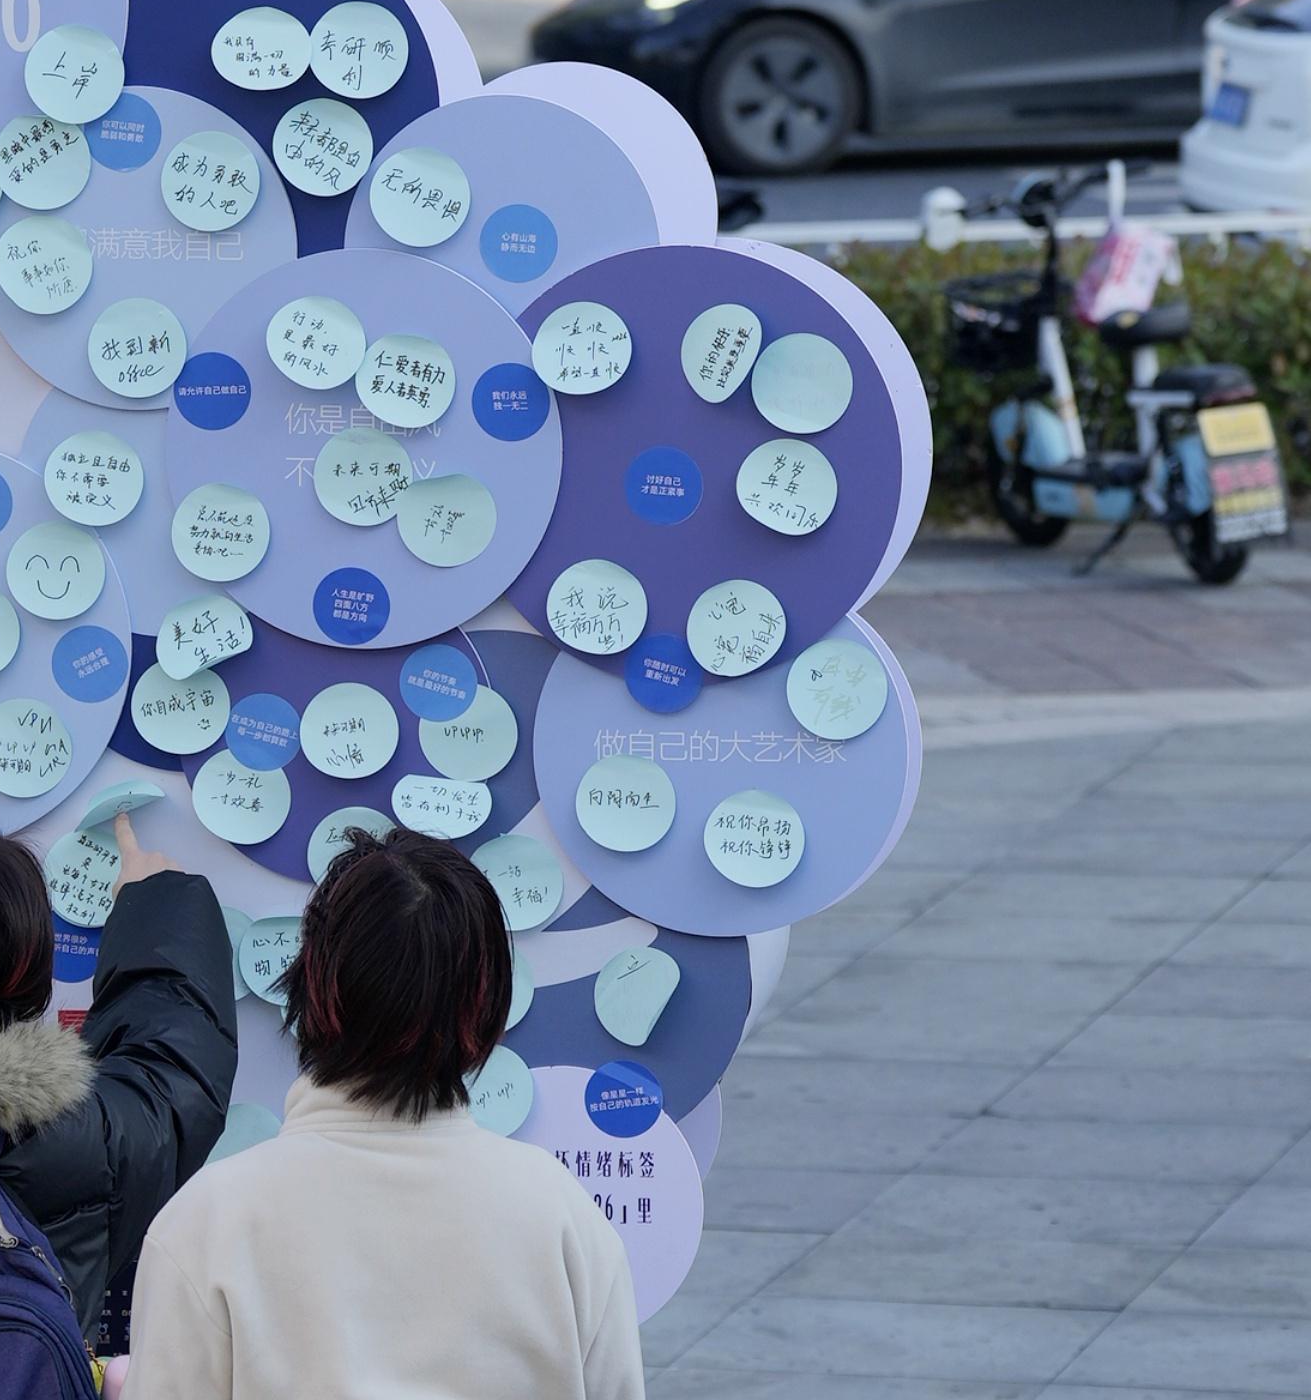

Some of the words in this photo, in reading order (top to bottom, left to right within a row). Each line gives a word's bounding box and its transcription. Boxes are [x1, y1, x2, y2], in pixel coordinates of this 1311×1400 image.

[42, 51, 98, 99] 上岸
[101, 119, 145, 132] 你可以同时
[172, 152, 253, 194] 成为勇敢
[285, 140, 341, 191] 由的风
[175, 183, 238, 215] 的人吧
[382, 168, 462, 222] 无所畏惧
[85, 227, 244, 262] 满意我自己
[501, 232, 537, 244] 心有山海
[7, 240, 42, 262] 祝你
[20, 256, 72, 288] 事事如你
[45, 277, 77, 299] 所愿
[102, 331, 172, 360] 找到新
[283, 329, 339, 357] 是最好
[283, 351, 328, 377] 的风水
[374, 350, 446, 385] 仁爱者有力
[178, 385, 247, 397] 请允许自己做自己
[492, 390, 528, 401] 我们永远
[493, 401, 529, 411] 独一无二
[62, 451, 131, 472] 独立且自由
[333, 461, 401, 477] 未来可期
[773, 453, 806, 479] 岁岁
[56, 468, 110, 488] 你不需要
[645, 474, 681, 487] 讨好自己
[761, 473, 801, 497] 年年
[66, 491, 116, 511] 被定义
[744, 492, 819, 529] 共欢同乐
[331, 588, 375, 603] 人生是旷野
[333, 599, 368, 613] 四面八方
[560, 586, 628, 612] 我说
[332, 608, 368, 623] 都是方向
[550, 609, 622, 640] 幸福万万
[172, 609, 219, 650] 美好
[423, 668, 457, 686] 你的节奏
[643, 657, 687, 677] 你随时可以
[644, 669, 679, 686] 重新出发
[140, 689, 215, 718] 你自成宇宙
[231, 713, 298, 741] 在成为自己的路上
[593, 728, 848, 764] 做自己的大艺术家
[218, 769, 264, 789] 一岁一礼
[211, 793, 264, 813] 一寸欢喜
[413, 784, 480, 808] 一切发生
[588, 788, 660, 809] 向阳而生
[401, 795, 481, 824] 皆有利于我
[714, 813, 792, 838] 祝你昂扬
[601, 1087, 644, 1099] 像星星一样
